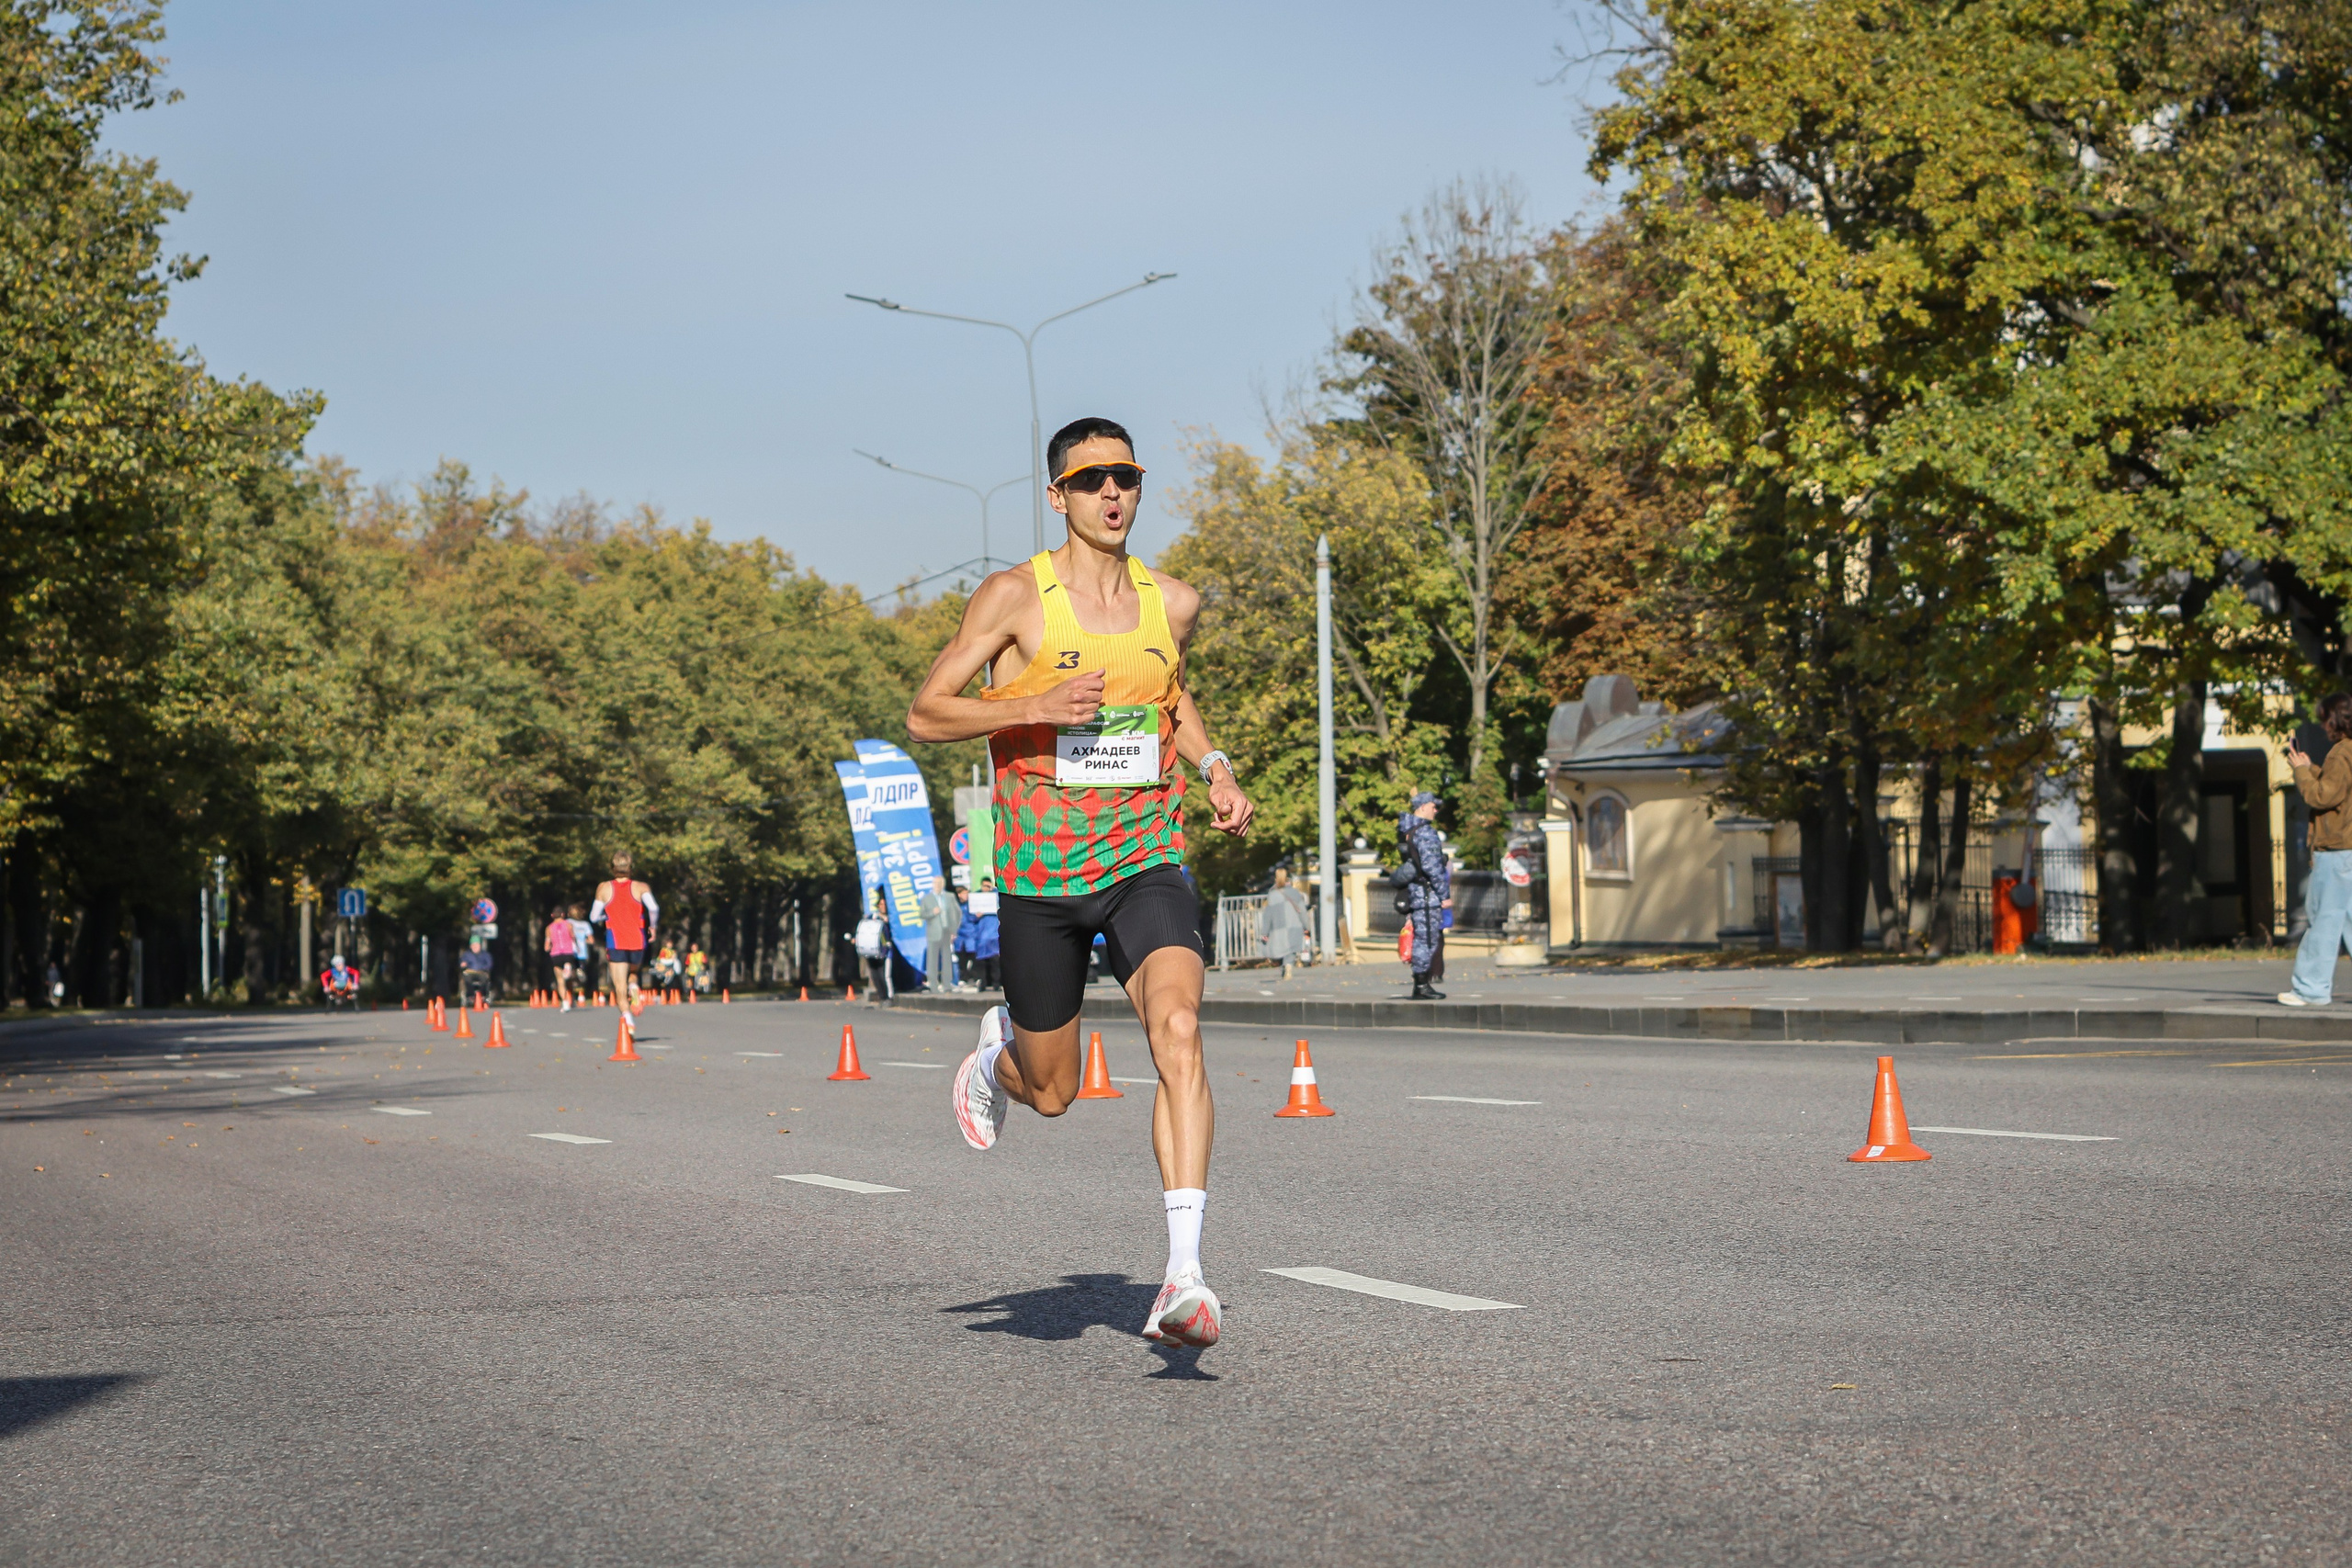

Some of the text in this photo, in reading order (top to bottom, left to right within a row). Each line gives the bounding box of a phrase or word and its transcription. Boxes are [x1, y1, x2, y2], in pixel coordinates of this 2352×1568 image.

[1070, 746, 1140, 757] АХМАДЕЕВ
[1085, 760, 1128, 770] РИНАС
[873, 783, 918, 805] ЛДПР
[854, 807, 872, 825] ЛД
[888, 871, 923, 928] ЛДПР
